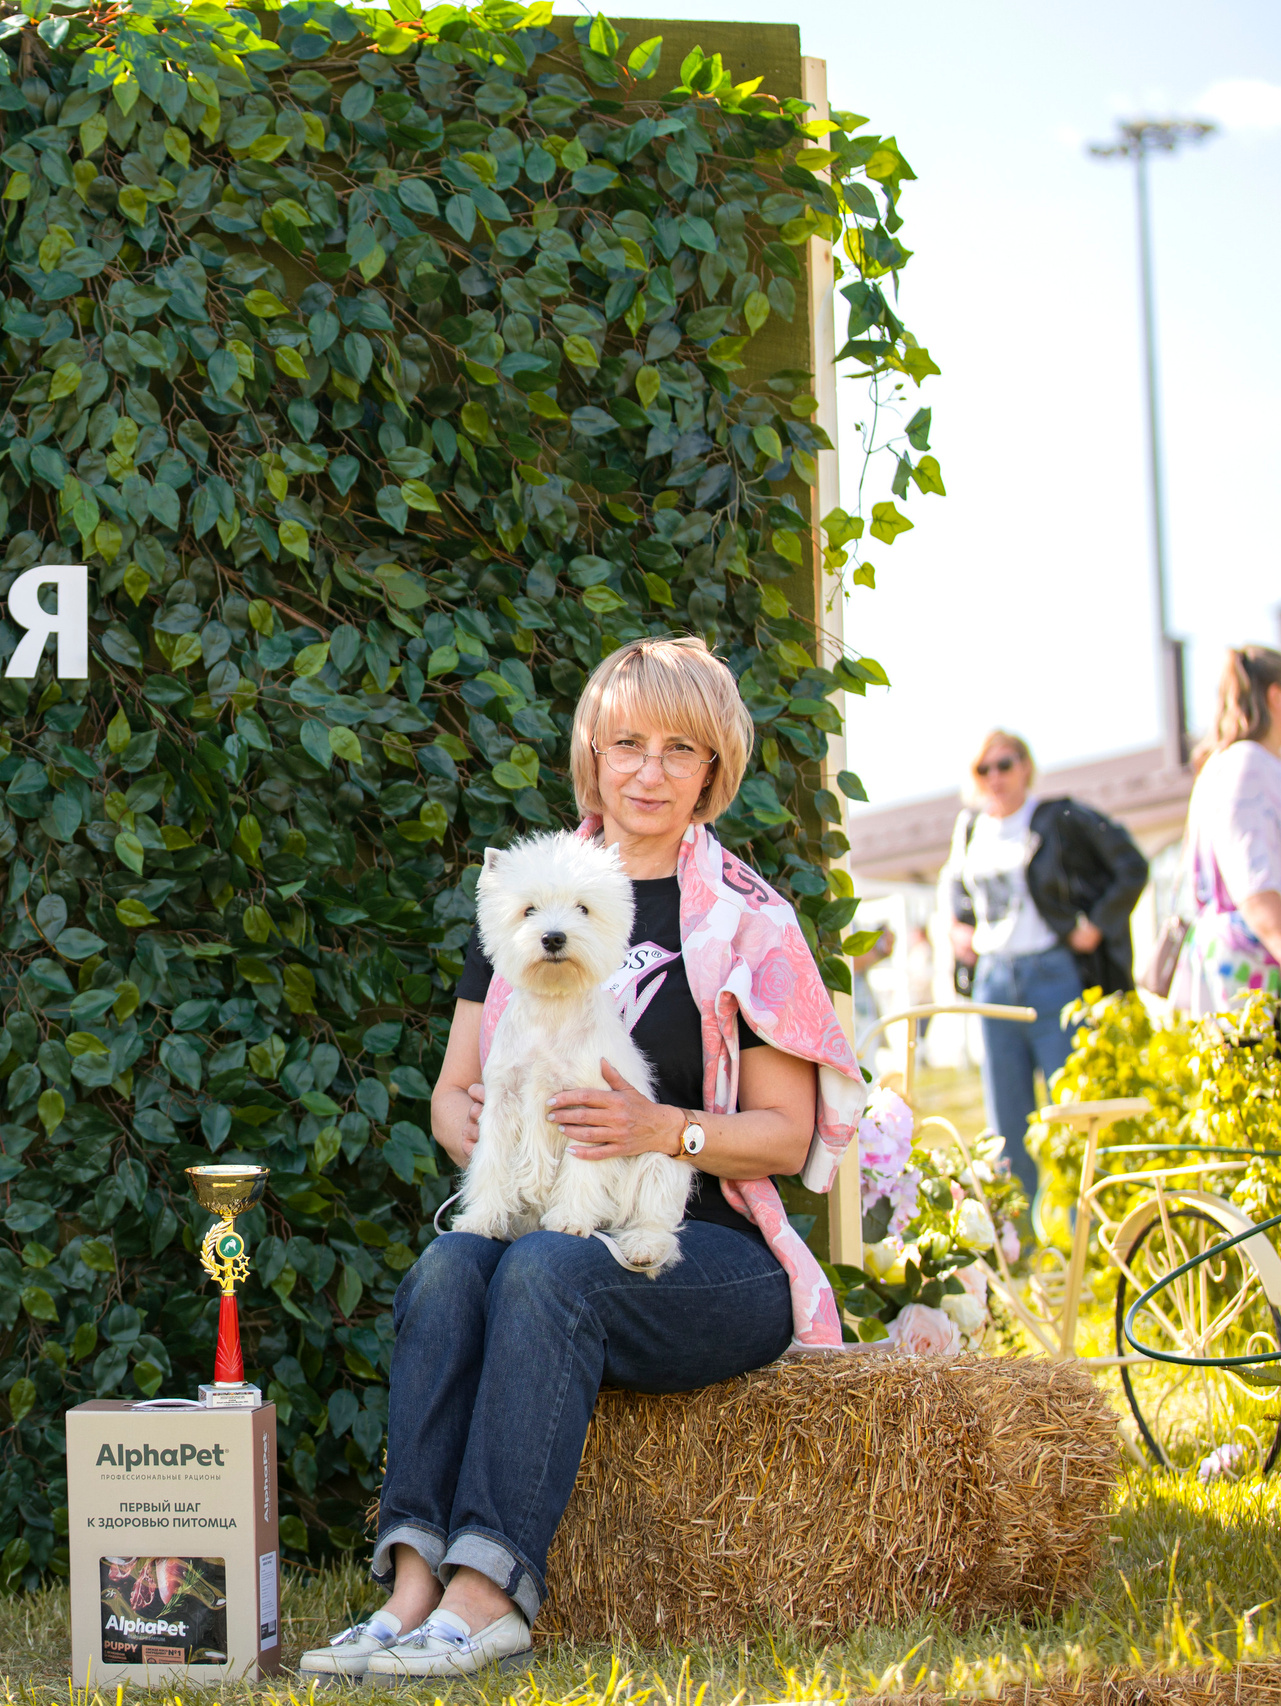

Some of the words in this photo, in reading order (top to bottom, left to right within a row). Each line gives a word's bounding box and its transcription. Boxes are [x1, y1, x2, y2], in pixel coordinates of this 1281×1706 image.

[96, 1443, 225, 1472] AlphaPet
[119, 1499, 171, 1513] ПЕРВЫЙ
[174, 1502, 201, 1513] ШАГ
[87, 1517, 96, 1528] К
[98, 1517, 170, 1530] ЗДОРОВЬЮ
[173, 1517, 237, 1530] ПИТОМЦА
[104, 1614, 187, 1637] AlphaPet
[104, 1640, 138, 1653] PUPPY
